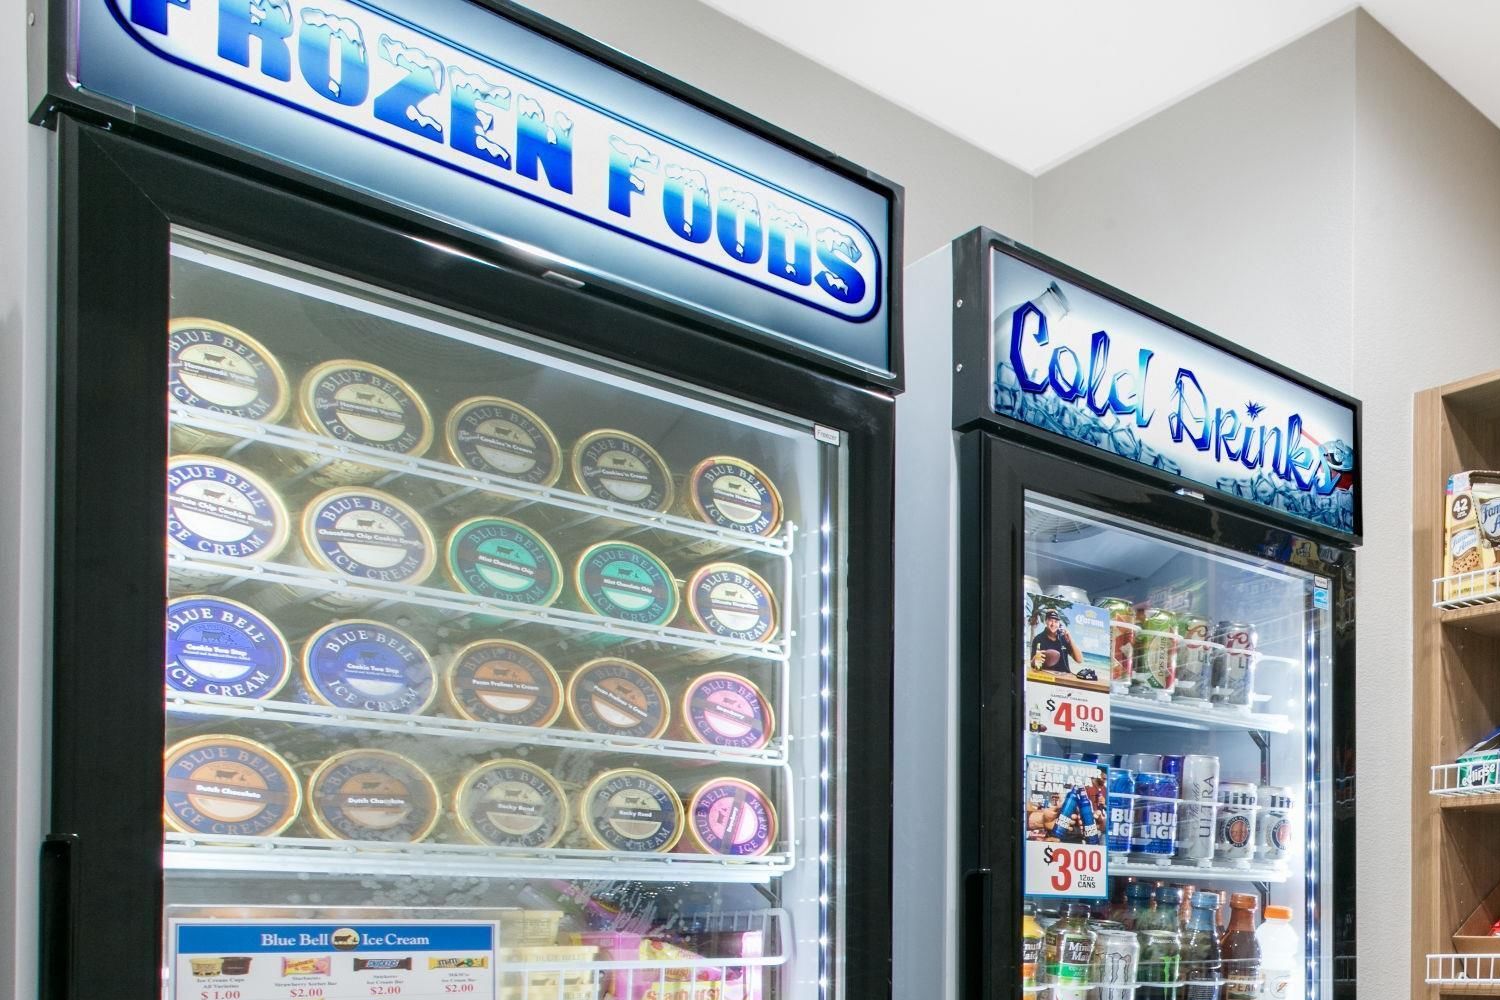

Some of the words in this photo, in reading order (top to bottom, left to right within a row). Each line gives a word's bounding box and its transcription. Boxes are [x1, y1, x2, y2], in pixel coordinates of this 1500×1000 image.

[608, 135, 867, 304] FOODS
[321, 371, 362, 392] BLUE
[371, 371, 410, 408] BELL
[1010, 301, 1155, 428] Cold
[1169, 368, 1342, 495] Drinks
[169, 467, 217, 487] BLUE
[224, 472, 267, 508] BELL
[705, 465, 735, 482] BLUE
[739, 468, 769, 497] BELL
[322, 497, 362, 522] BLUE
[371, 499, 409, 532] BELL
[1453, 499, 1468, 513] 42
[198, 535, 265, 558] CREAM
[366, 557, 418, 581] CREAM
[701, 571, 731, 590] BLUE
[734, 573, 764, 599] BELL
[168, 609, 213, 633] BLUE
[221, 611, 265, 643] BELL
[705, 613, 726, 634] ICE
[326, 630, 368, 653] BLUE
[376, 632, 415, 662] BELL
[166, 662, 197, 688] ICE
[204, 670, 270, 697] CREAM
[328, 680, 358, 704] ICE
[364, 687, 419, 712] CREAM
[703, 681, 733, 695] BLUE
[736, 682, 760, 711] BELL
[1080, 726, 1098, 734] CANS
[178, 747, 228, 772] BLUE
[237, 752, 277, 783] BELL
[1029, 762, 1069, 776] CHEER
[1071, 765, 1102, 778] YOUR
[1031, 771, 1066, 785] TEAM
[175, 801, 202, 826] ICE
[212, 810, 277, 835] CREAM
[1077, 881, 1096, 889] CANS
[261, 934, 296, 947] Blue
[299, 933, 328, 946] Bell
[363, 933, 383, 946] Ice
[384, 933, 430, 946] Cream
[215, 991, 240, 1000] 1.00
[290, 989, 323, 998] $2.00
[370, 986, 401, 995] $2.00
[445, 984, 474, 993] $2.00
